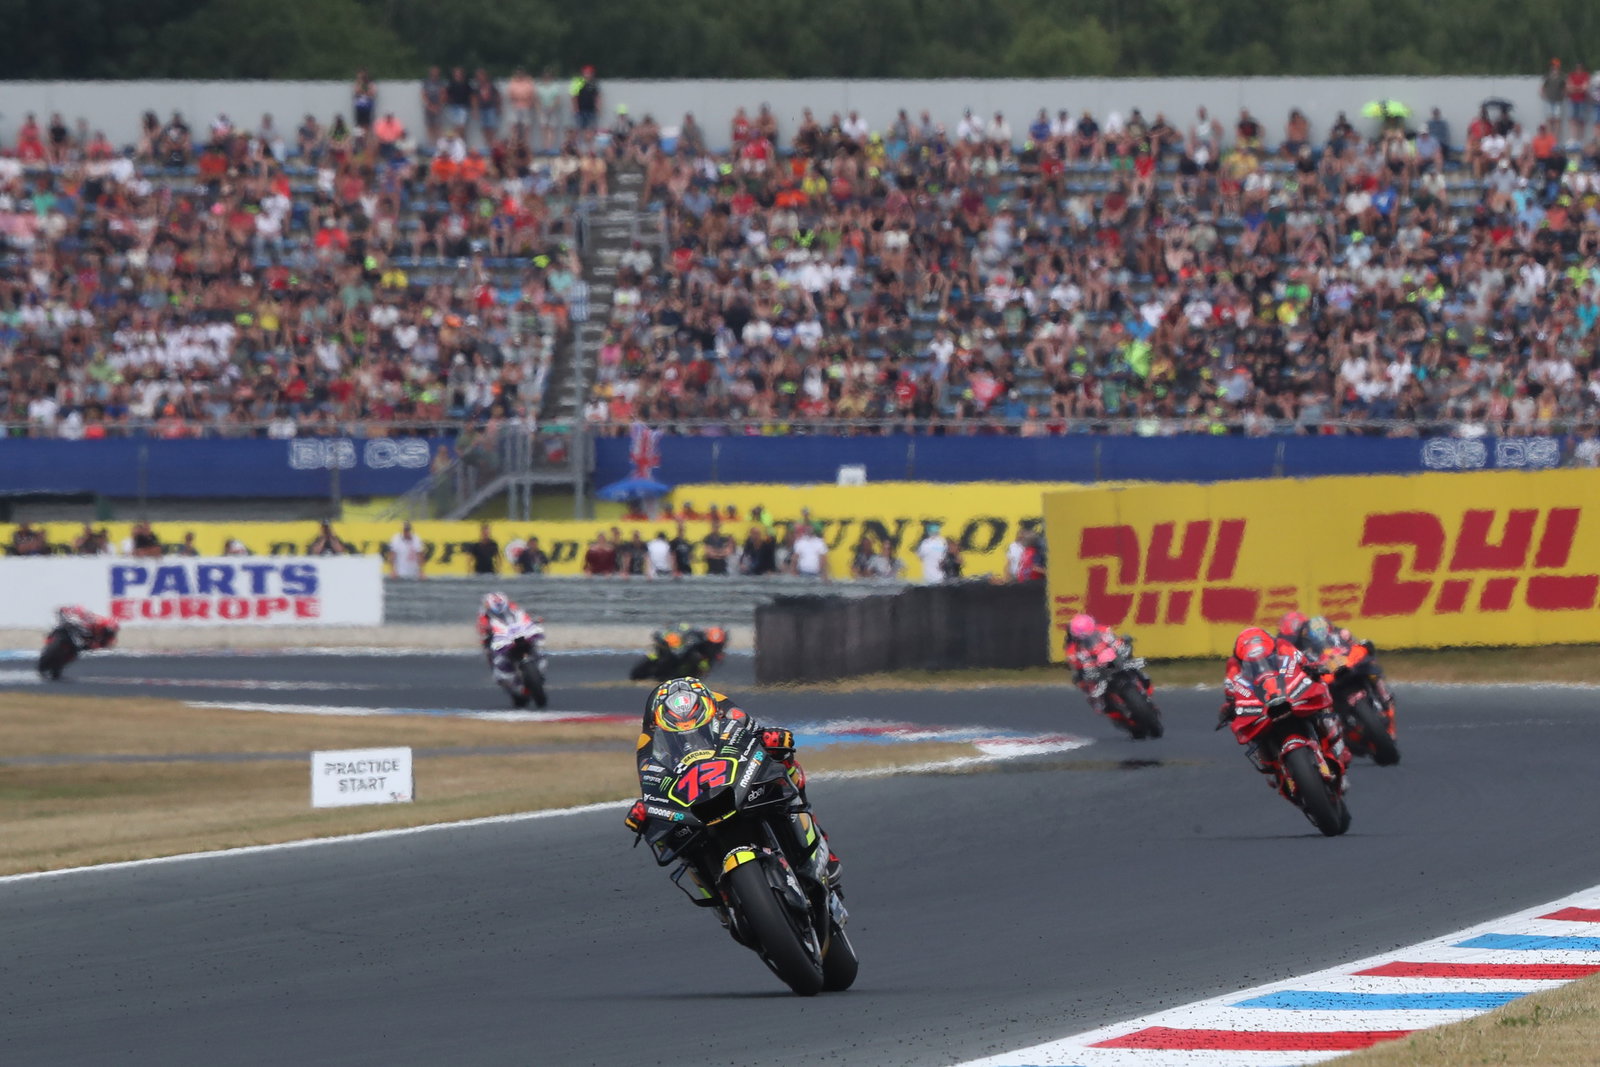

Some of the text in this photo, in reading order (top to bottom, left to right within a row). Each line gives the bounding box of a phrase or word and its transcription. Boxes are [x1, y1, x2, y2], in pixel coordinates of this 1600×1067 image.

[1079, 518, 1260, 626] DHL
[1357, 507, 1599, 618] DHL
[111, 563, 319, 597] PARTS
[110, 598, 320, 620] EUROPE
[324, 759, 400, 775] PRACTICE
[338, 777, 387, 792] START
